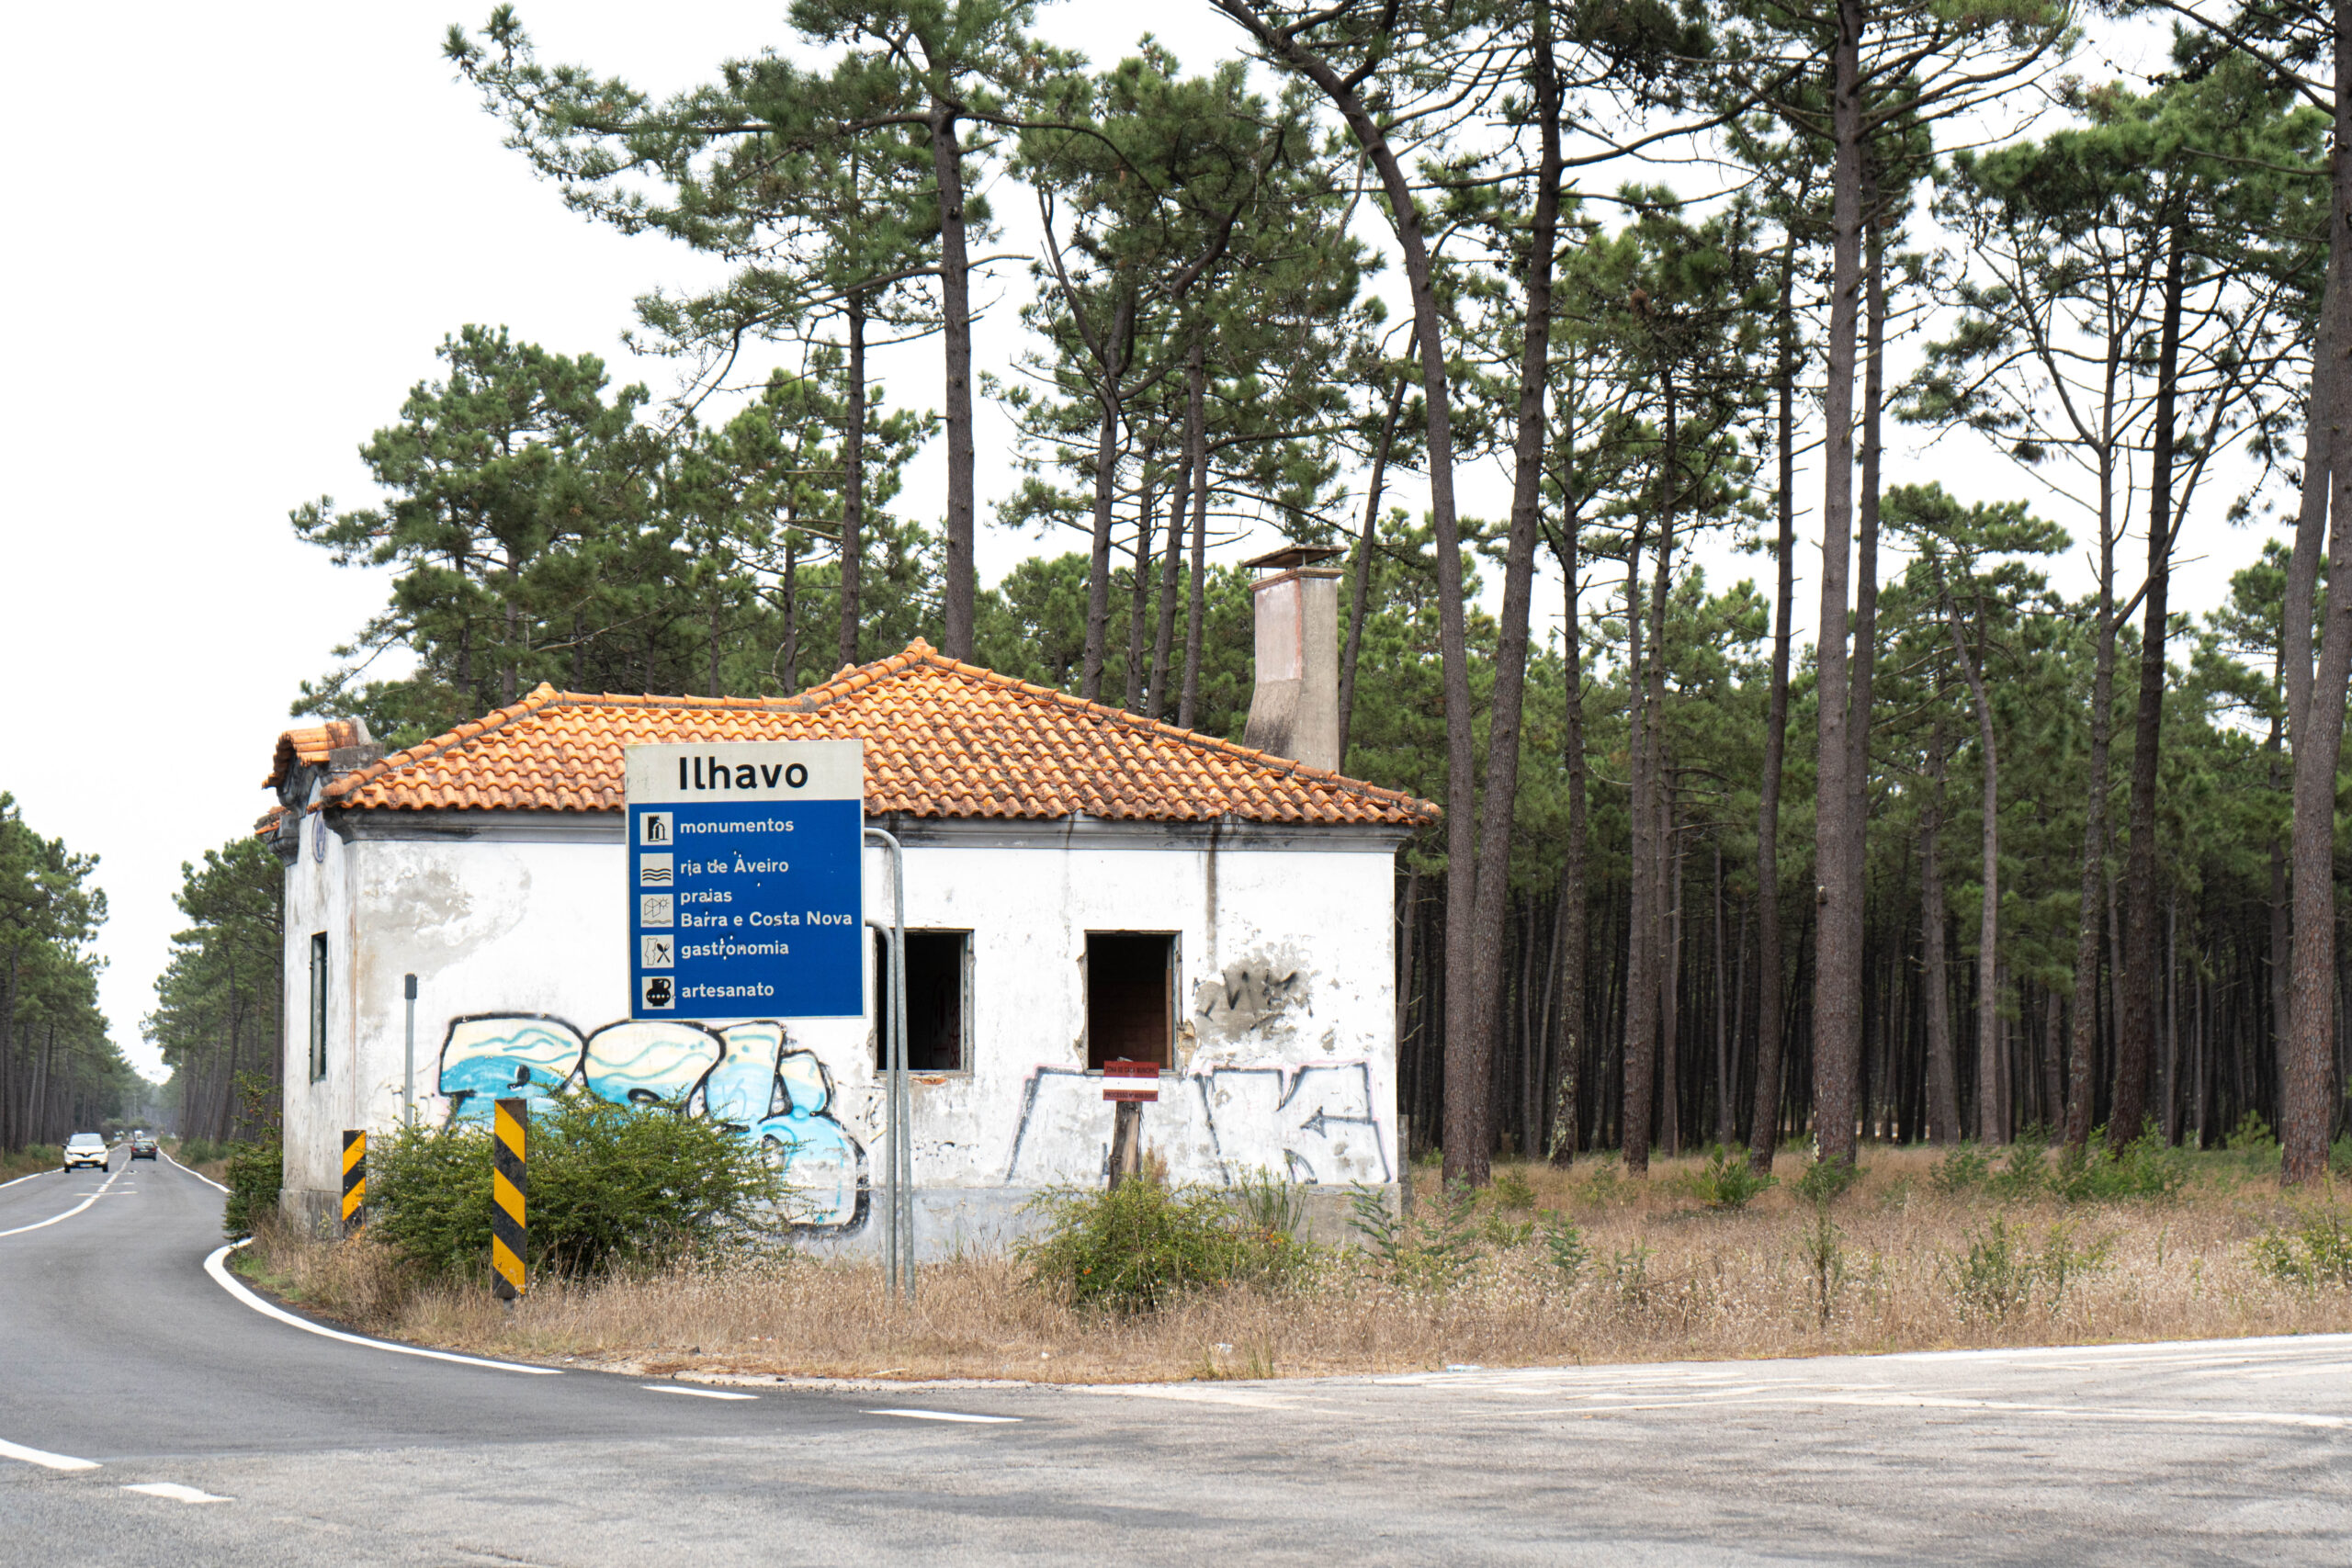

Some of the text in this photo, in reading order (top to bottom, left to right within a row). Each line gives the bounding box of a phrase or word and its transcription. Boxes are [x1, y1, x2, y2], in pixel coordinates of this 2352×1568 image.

[679, 756, 808, 790] Ilhavo
[680, 818, 794, 833] monumentos
[680, 860, 702, 874] ria
[707, 859, 729, 873] de
[680, 888, 732, 906] praias
[681, 911, 853, 927] Barra e Costa Nova
[681, 940, 789, 959] gastronomia
[682, 982, 775, 998] artesanato
